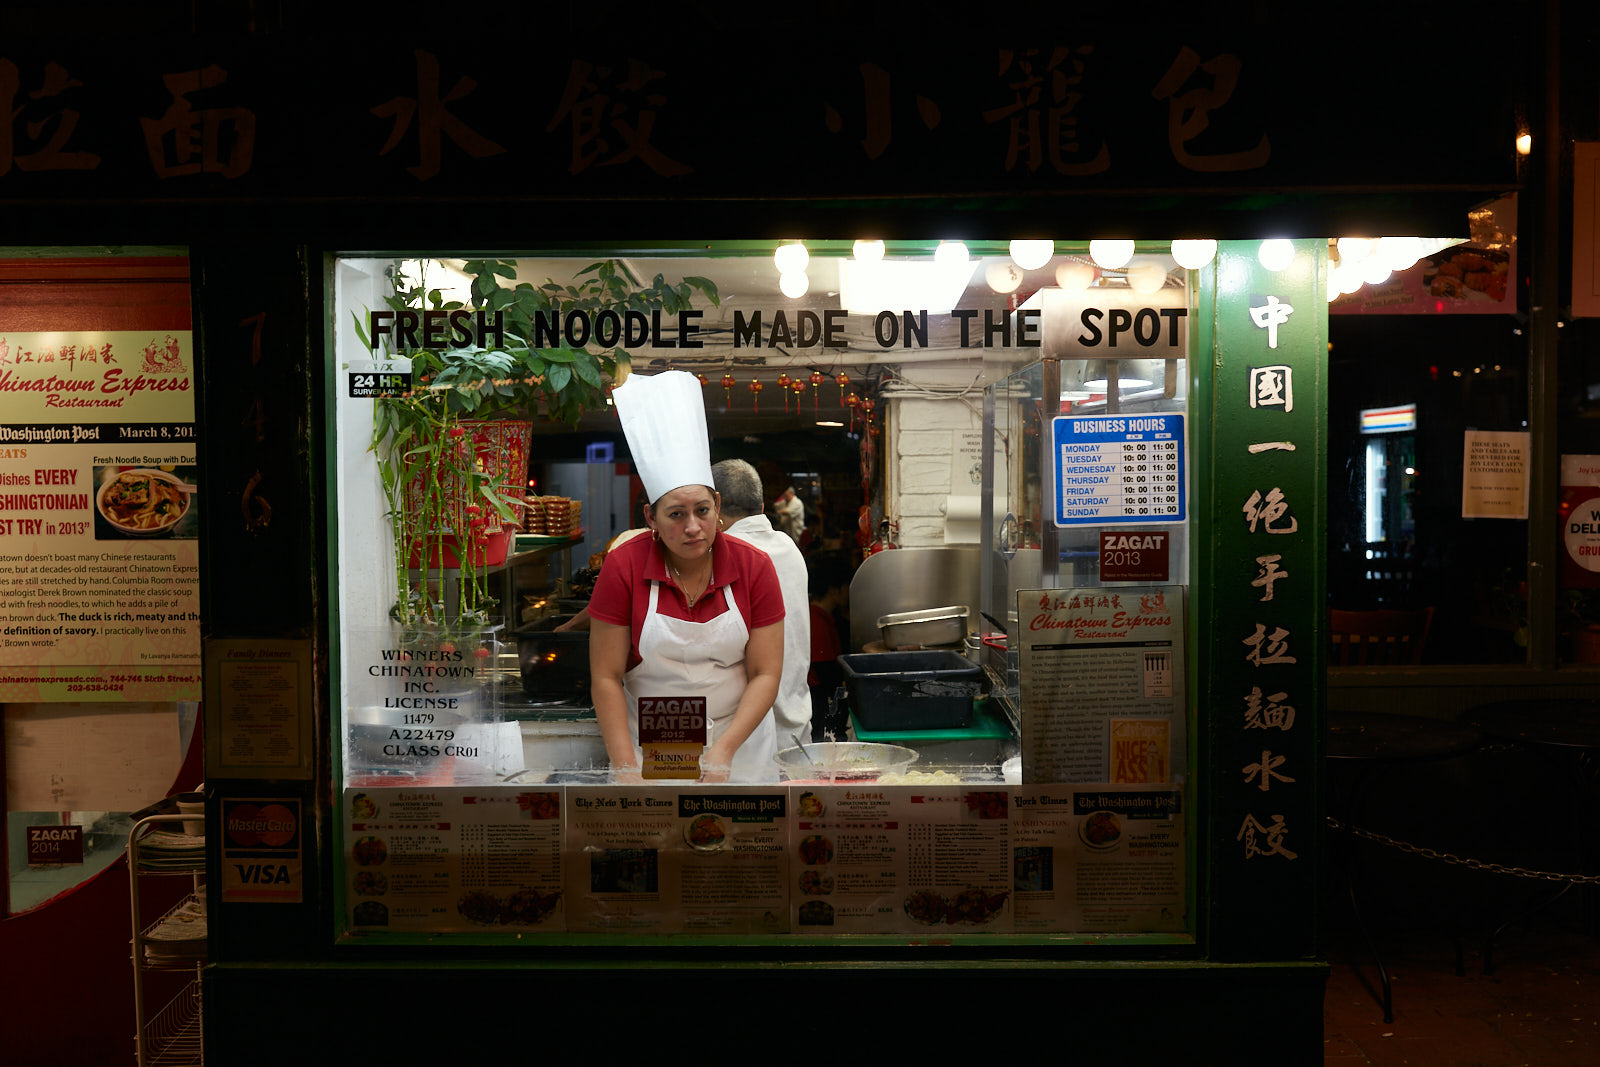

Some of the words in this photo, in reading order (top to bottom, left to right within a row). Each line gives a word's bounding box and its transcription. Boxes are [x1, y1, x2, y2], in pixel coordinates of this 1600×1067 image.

[370, 309, 503, 349] FRESH
[534, 309, 704, 348] NOODLE
[733, 309, 849, 348] MADE
[874, 309, 929, 348] ON
[951, 309, 1042, 348] THE
[1077, 308, 1188, 347] SPOT
[100, 368, 190, 397] Express
[354, 375, 375, 388] 24
[45, 394, 125, 408] Restaurant
[1073, 420, 1126, 434] BUSINESS
[1128, 418, 1166, 432] HOURS
[72, 426, 100, 443] Post
[119, 427, 158, 438] March
[160, 427, 172, 439] 8,
[174, 427, 196, 438] 201
[93, 456, 113, 464] Fresh
[115, 456, 141, 464] Noodle
[143, 456, 162, 465] Soup
[163, 456, 179, 464] with
[1066, 466, 1116, 474] WEDNESDAY
[34, 469, 78, 485] EVERY
[1066, 476, 1110, 484] THURSDAY
[1066, 498, 1110, 506] SATURDAY
[1067, 508, 1100, 516] SUNDAY
[17, 519, 43, 535] TRY
[46, 523, 55, 535] in
[1104, 535, 1165, 550] ZAGAT
[25, 554, 53, 562] doesn't
[54, 554, 76, 562] boast
[78, 556, 99, 564] many
[100, 554, 132, 562] Chinese
[133, 554, 176, 562] restaurants
[1104, 551, 1140, 565] 2013
[15, 565, 29, 573] but
[31, 565, 38, 573] at
[39, 565, 87, 573] decades-old
[88, 565, 128, 573] restaurant
[129, 565, 171, 573] Chinatown
[25, 576, 39, 584] still
[40, 576, 77, 584] stretched
[78, 576, 88, 586] by
[90, 576, 111, 584] hand.
[112, 576, 149, 584] Columbia
[150, 576, 174, 584] Room
[38, 588, 60, 596] Derek
[62, 588, 87, 596] Brown
[88, 588, 131, 596] nominated
[132, 588, 146, 596] the
[147, 588, 172, 596] classic
[172, 590, 192, 598] soup
[8, 600, 26, 608] with
[27, 600, 46, 608] fresh
[48, 600, 80, 610] noodles,
[92, 600, 115, 608] which
[128, 600, 146, 608] adds
[154, 600, 168, 610] pile
[170, 600, 178, 608] of
[9, 613, 35, 622] brown
[36, 613, 57, 622] duck.
[78, 613, 101, 622] duck
[104, 613, 112, 622] is
[114, 613, 134, 624] rich,
[136, 613, 166, 624] meaty
[168, 613, 186, 622] and
[1029, 613, 1109, 632] Chinatown
[1111, 611, 1172, 630] Express
[4, 626, 50, 634] definition
[52, 626, 63, 634] of
[65, 628, 100, 636] savory.
[104, 626, 144, 636] practically
[145, 626, 158, 634] live
[172, 626, 187, 634] this
[1073, 629, 1128, 640] Restaurant
[382, 650, 463, 661] WINNERS
[368, 666, 475, 677] CHINATOWN
[110, 674, 142, 683] 744-746
[144, 674, 165, 683] Sixth
[167, 674, 195, 684] Street,
[67, 684, 124, 692] 202-638-0424
[404, 682, 440, 693] INC.
[384, 698, 458, 709] LICENSE
[641, 700, 703, 714] ZAGAT
[404, 714, 434, 724] 11479
[641, 716, 703, 730] RATED
[389, 729, 455, 741] A22479
[383, 745, 440, 757] CLASS
[444, 746, 478, 757] CR01
[1116, 740, 1148, 762] NICE
[575, 797, 594, 809] The
[595, 797, 617, 810] New
[620, 797, 642, 810] York
[645, 797, 673, 807] Times
[682, 799, 702, 810] The
[703, 796, 757, 811] Washington
[759, 798, 781, 811] Post
[1014, 796, 1036, 808] York
[1040, 795, 1068, 805] Times
[1079, 798, 1096, 808] The
[1097, 795, 1153, 809] Washington
[228, 817, 293, 832] MasterCard
[31, 829, 77, 841] ZAGAT
[31, 841, 61, 854] 2014
[236, 864, 291, 884] VISA
